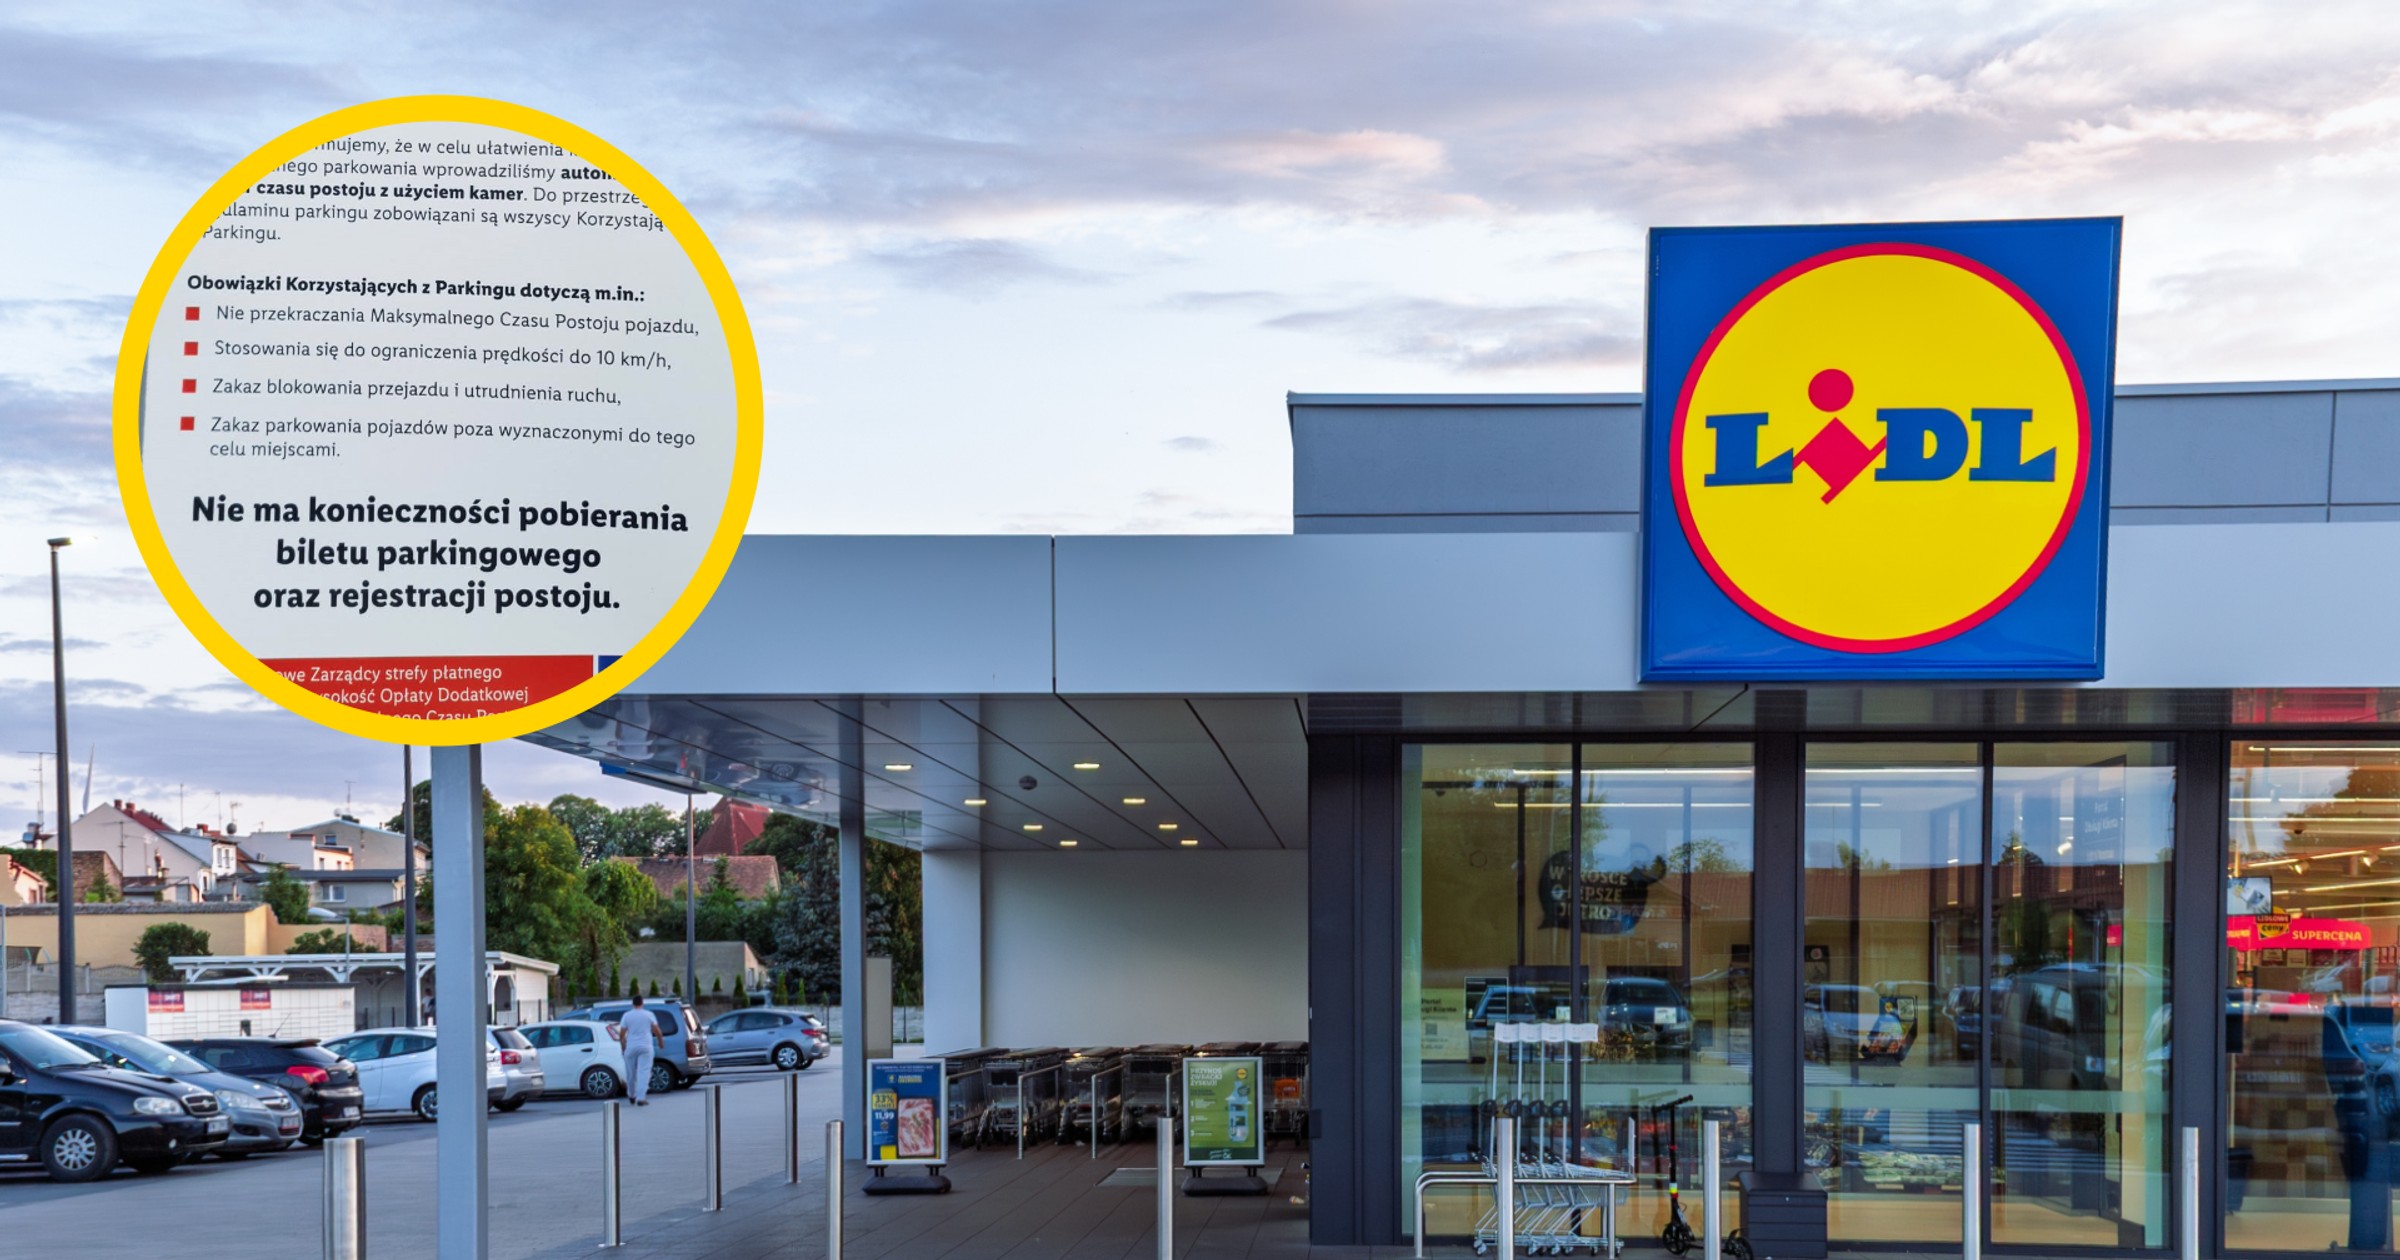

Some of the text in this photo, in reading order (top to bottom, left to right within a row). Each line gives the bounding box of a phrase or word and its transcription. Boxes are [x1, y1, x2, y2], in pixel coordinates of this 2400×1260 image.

[315, 137, 564, 157] mujemy, że w celu ułatwienia
[323, 159, 418, 177] parkowania
[422, 163, 556, 183] wprowadziliśmy
[256, 183, 306, 195] czasu
[309, 181, 376, 201] postoju
[379, 186, 389, 198] z
[393, 183, 465, 202] użyciem
[469, 184, 528, 201] kamer.
[533, 186, 557, 202] Do
[562, 190, 648, 209] przestrze
[221, 201, 290, 218] ulaminu
[295, 203, 368, 223] parkingu
[373, 205, 475, 225] zobowiązani
[481, 211, 498, 227] są
[503, 212, 571, 229] wszyscy
[187, 274, 645, 304] Obowiązki Korzystających z Parkingu dotyczą m.in.:
[217, 305, 699, 336] Nie przekraczania Maksymalnego Czasu Postoju pojazdu,
[215, 339, 671, 371] Stosowania się do ograniczenia prędkości do 10 km/h,
[212, 378, 621, 406] Zakaz blokowania przejazdu i utrudnienia ruchu,
[211, 416, 695, 449] Zakaz parkowania pojazdów poza wyznaczonymi do tego
[210, 441, 340, 460] celu miejscami.
[192, 494, 689, 533] Nie ma konieczności pobierania
[276, 536, 602, 574] biletu parkingowego
[253, 579, 620, 615] oraz rejestracji postoju.
[310, 666, 381, 684] Zarządcy
[385, 665, 429, 682] strefy
[432, 664, 502, 682] płatnego
[380, 687, 433, 706] Opłaty
[438, 686, 529, 704] Dodatkowej
[2291, 930, 2363, 941] SUPERCENA
[874, 1112, 894, 1120] 11,99
